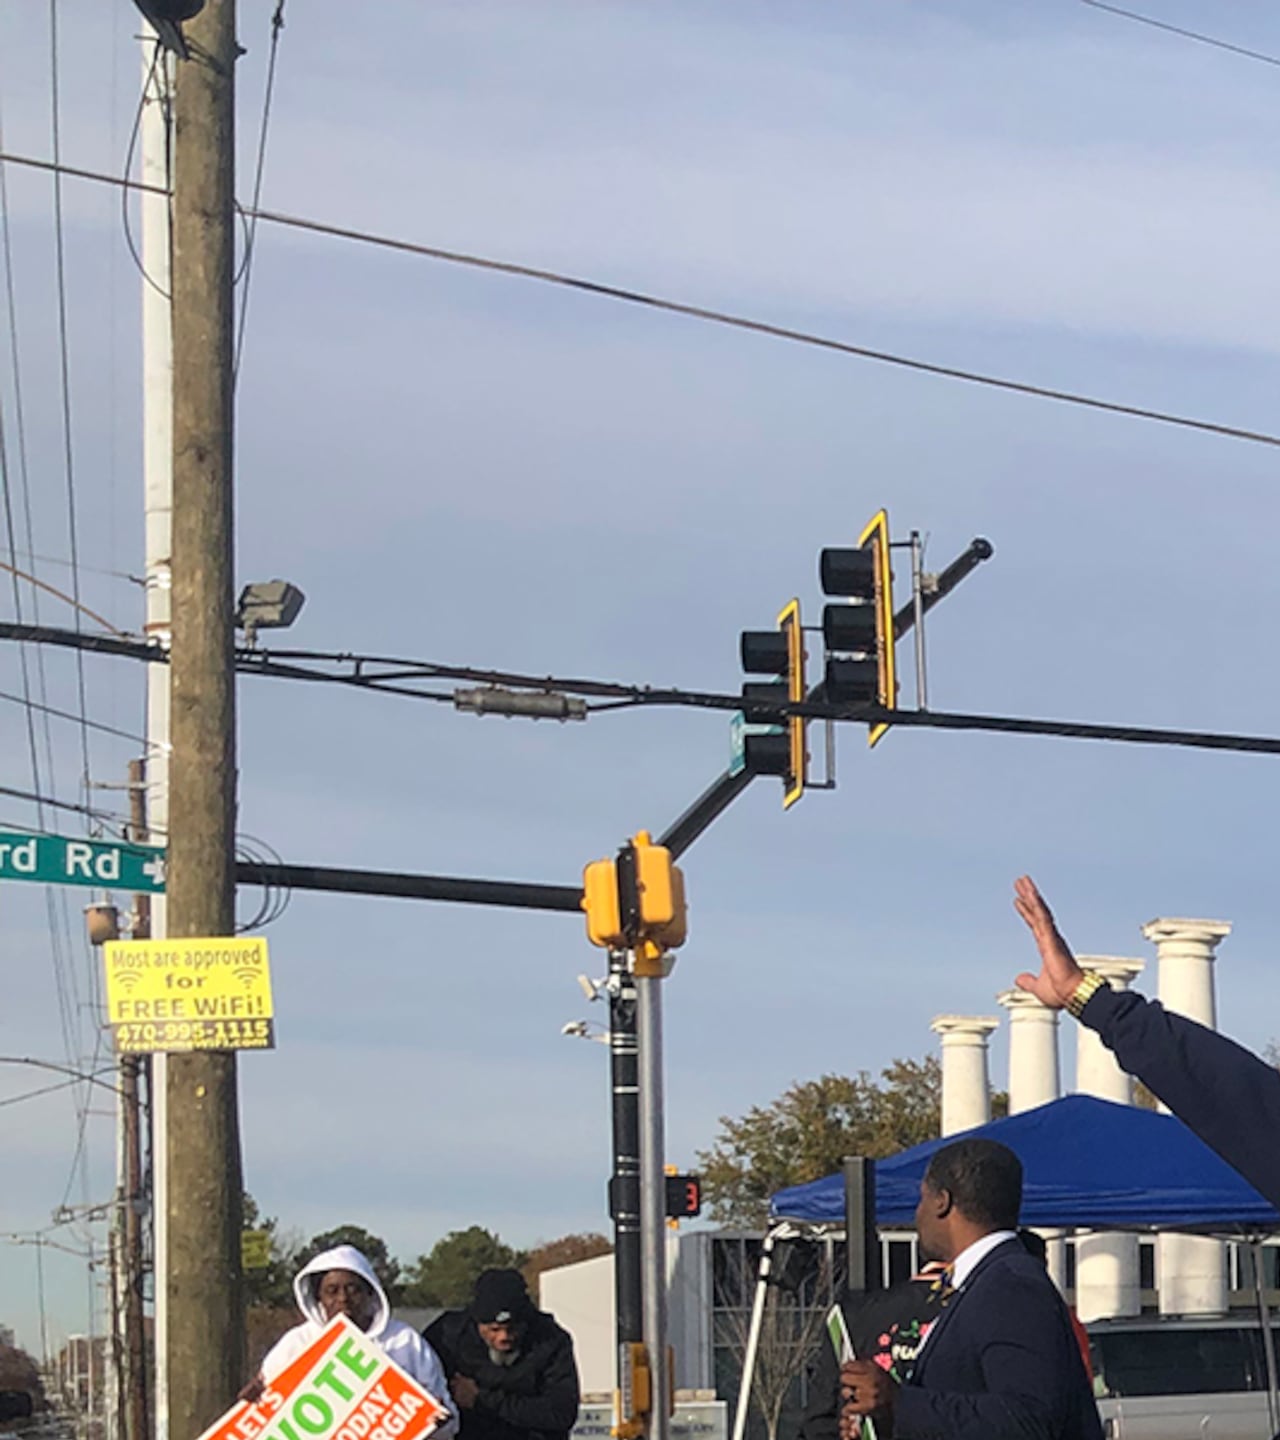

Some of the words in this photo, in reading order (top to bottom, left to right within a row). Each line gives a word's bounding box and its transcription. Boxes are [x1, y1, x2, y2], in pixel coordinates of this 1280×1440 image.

[66, 841, 120, 881] Rd
[112, 950, 150, 968] Most
[154, 951, 181, 967] are
[185, 944, 262, 970] approved
[165, 973, 207, 989] for
[117, 998, 186, 1018] FREE
[194, 994, 264, 1016] WiFi!
